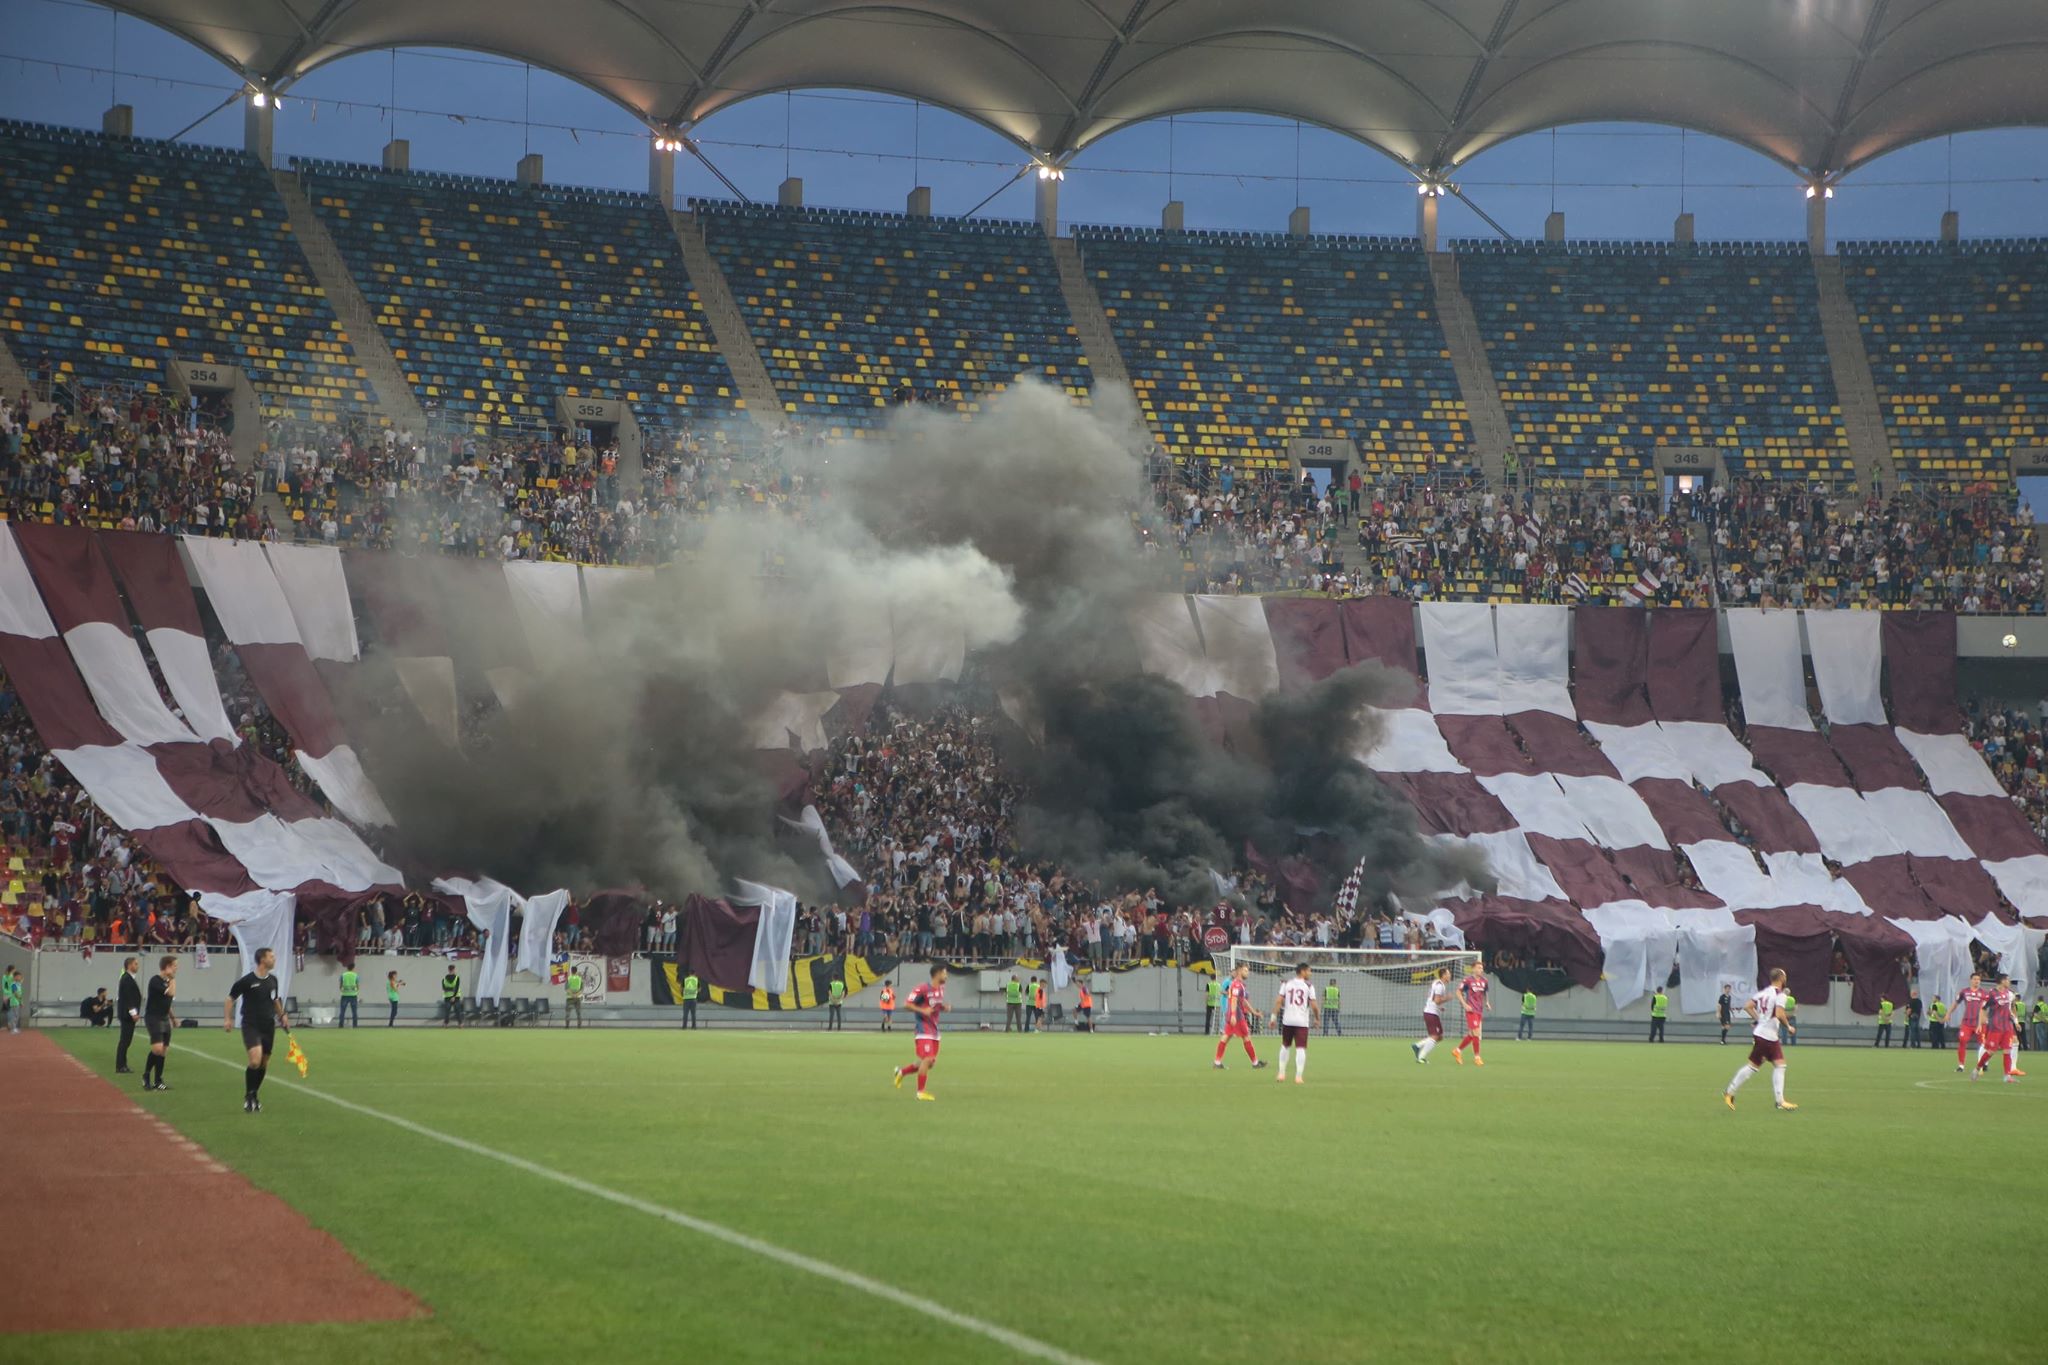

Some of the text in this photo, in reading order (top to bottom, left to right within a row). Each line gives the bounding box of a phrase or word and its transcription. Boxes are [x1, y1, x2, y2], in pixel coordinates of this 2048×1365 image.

[191, 369, 217, 382] 354
[578, 405, 603, 416] 352
[1308, 445, 1332, 455] 348
[1674, 454, 1699, 464] 346
[1206, 934, 1227, 944] STOP
[1288, 988, 1304, 1007] 13
